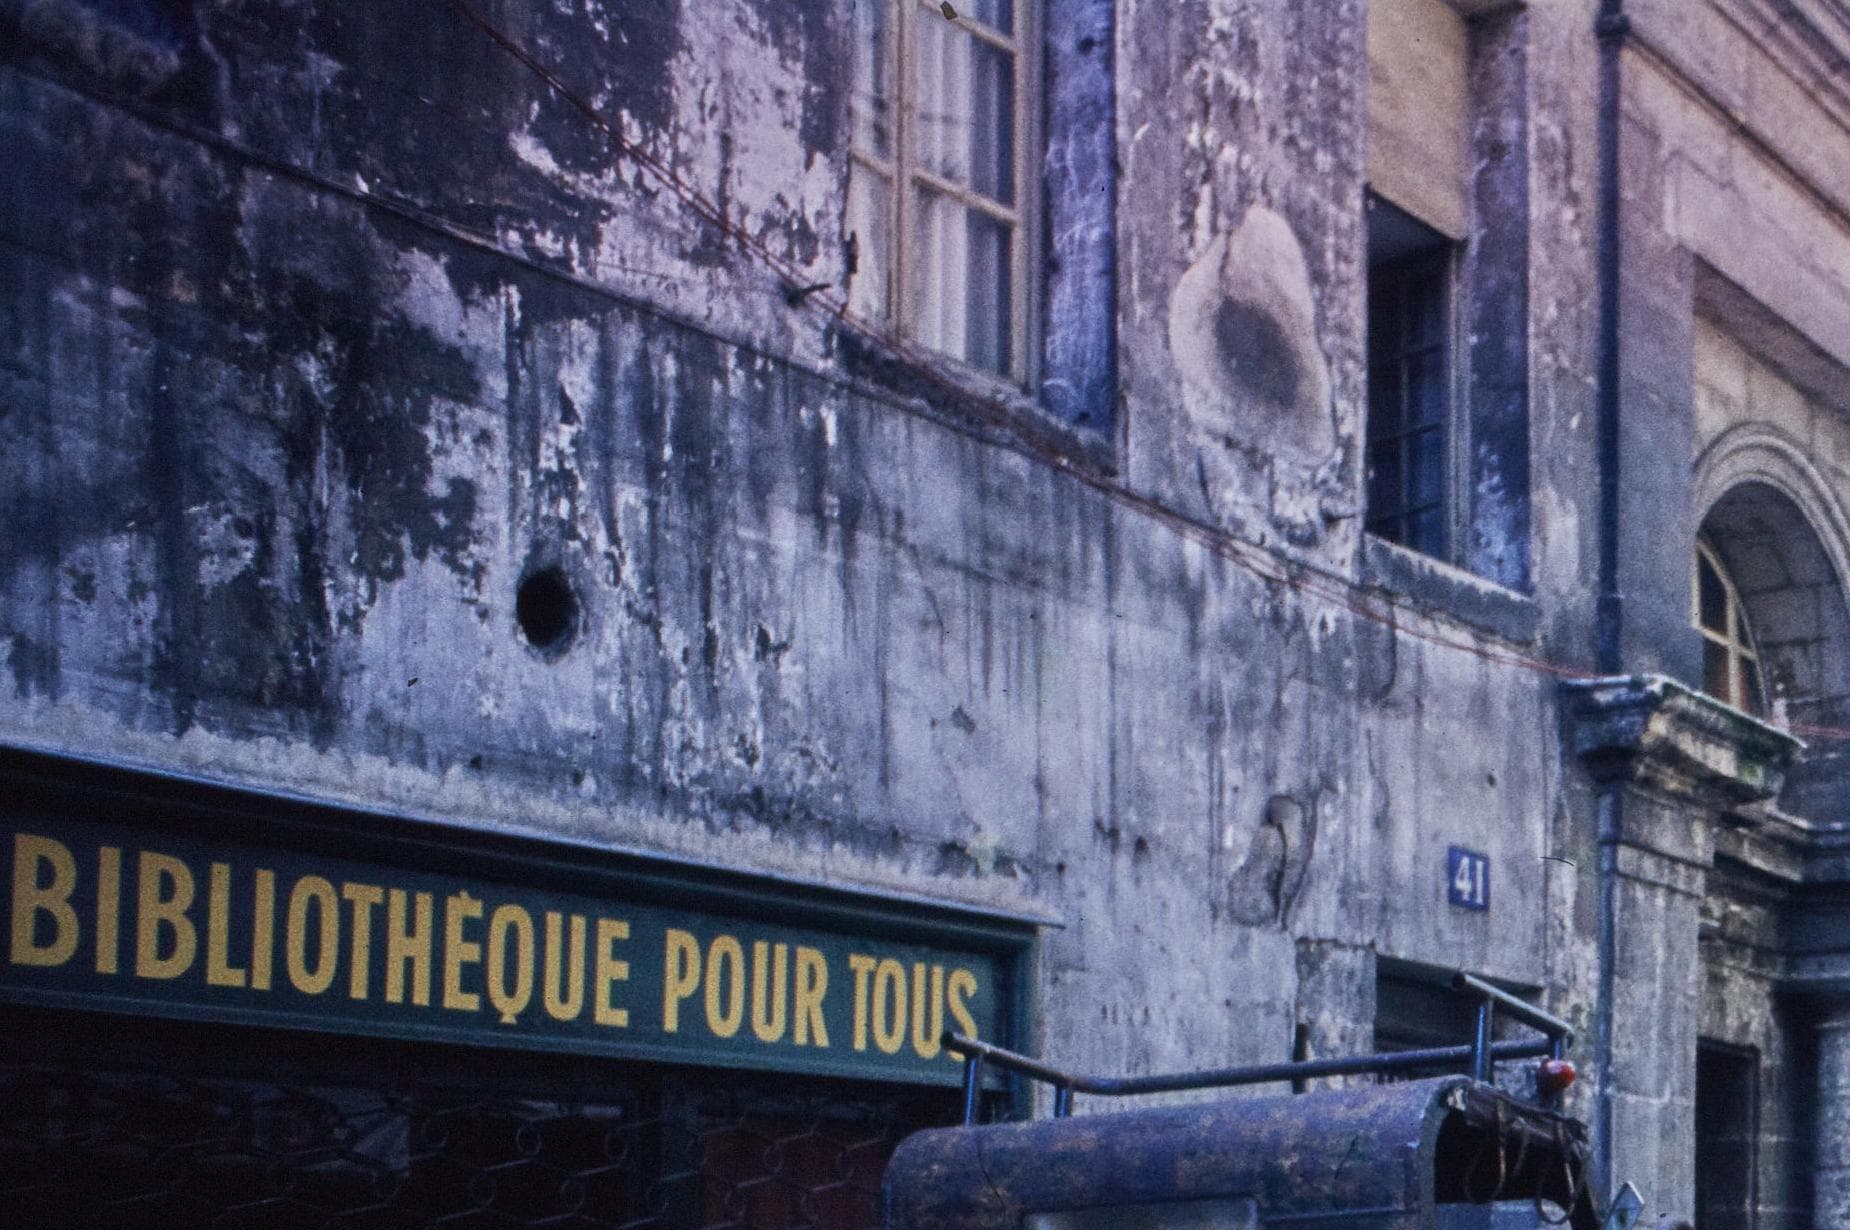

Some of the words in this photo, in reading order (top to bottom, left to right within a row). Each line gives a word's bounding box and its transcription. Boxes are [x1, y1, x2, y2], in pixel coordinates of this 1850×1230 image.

[10, 832, 632, 1029] BIBLIOTHÈQUE
[662, 927, 830, 1049] POUR
[849, 953, 979, 1063] TOUS
[1454, 856, 1485, 905] 41
